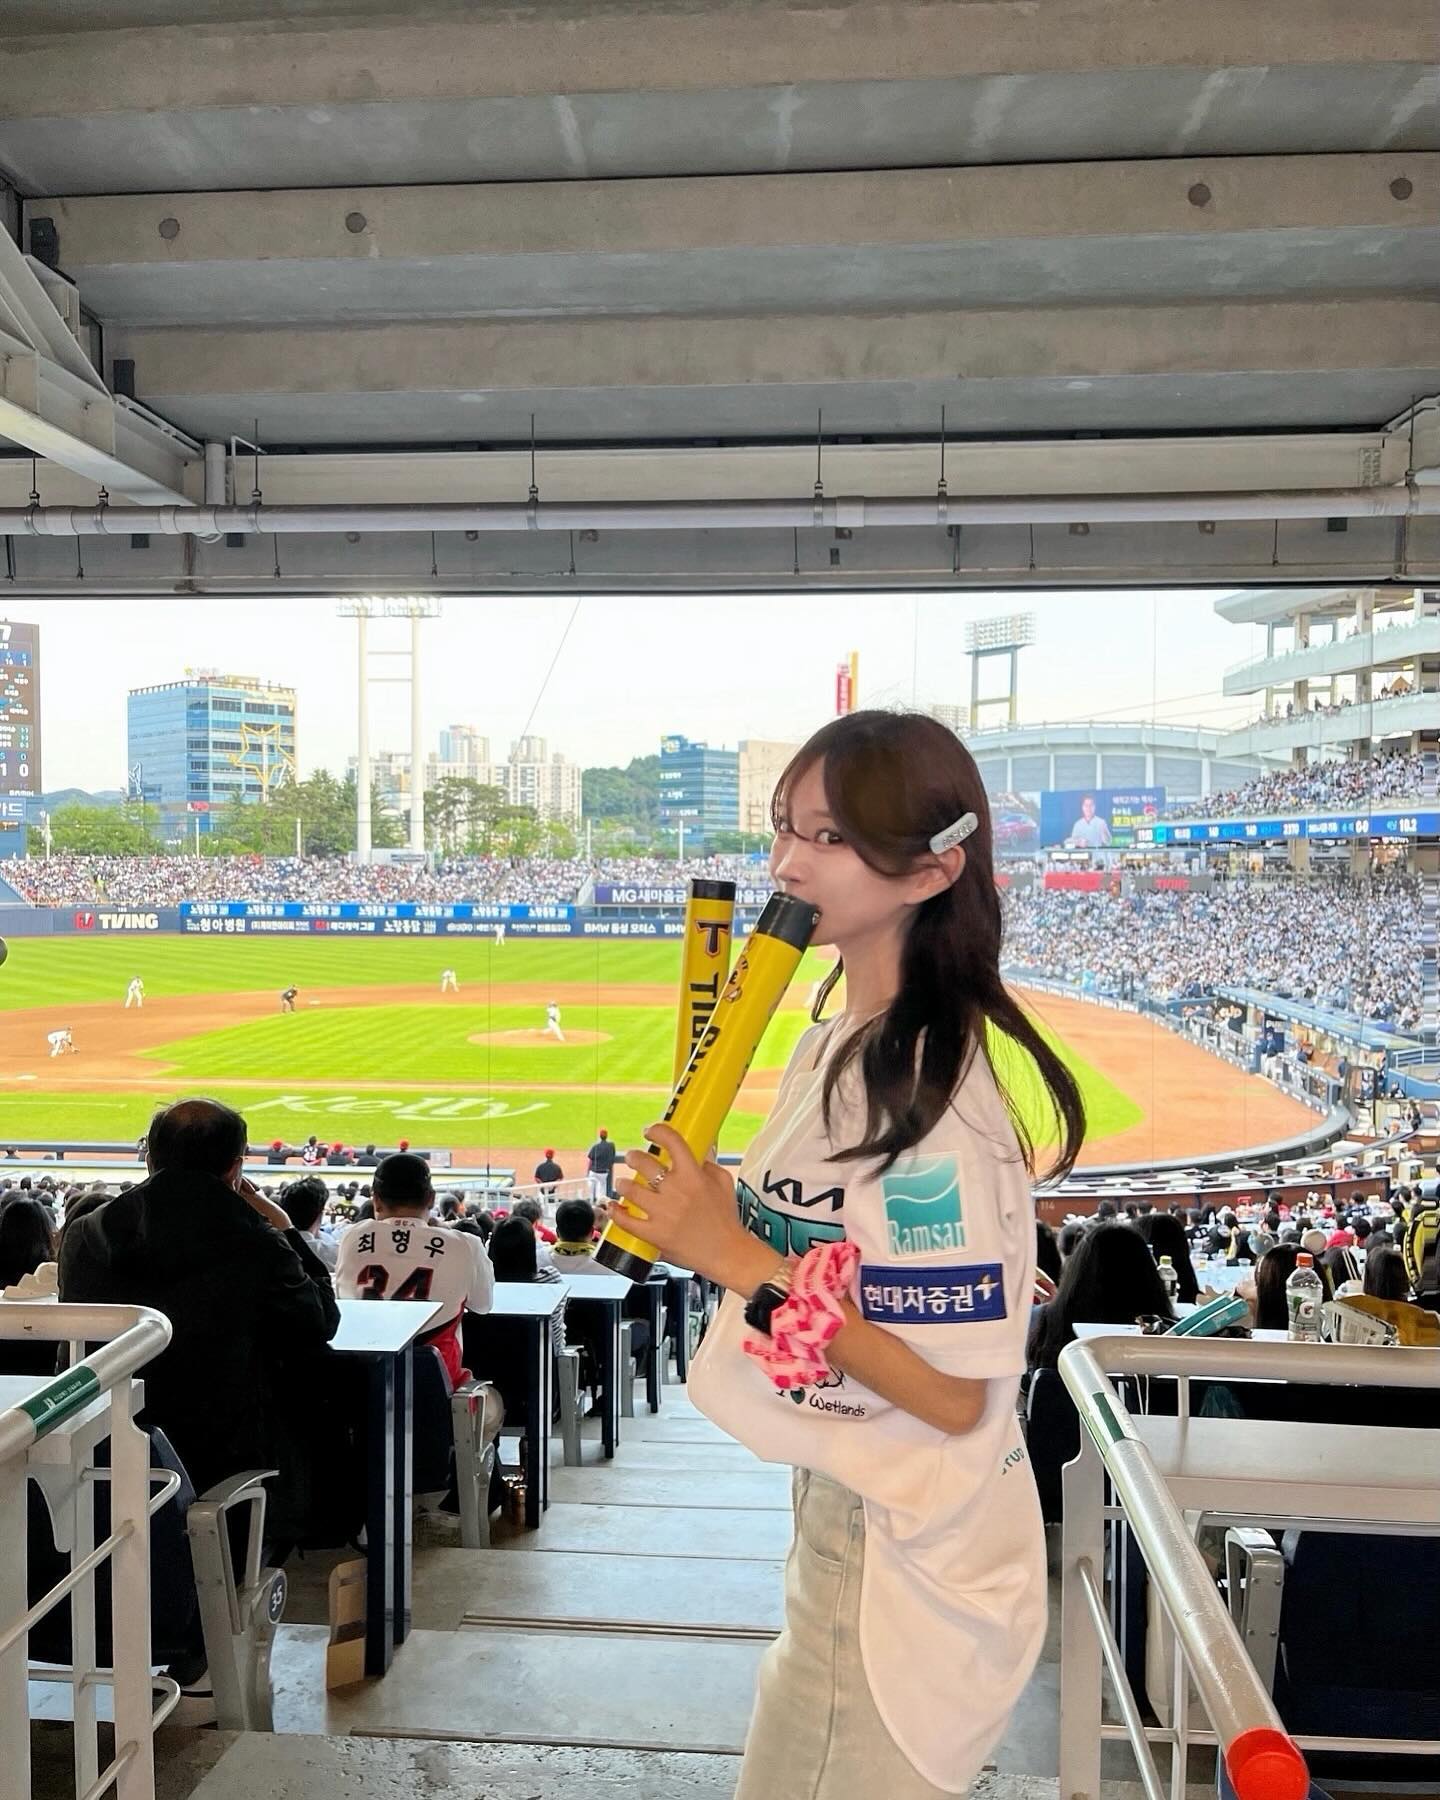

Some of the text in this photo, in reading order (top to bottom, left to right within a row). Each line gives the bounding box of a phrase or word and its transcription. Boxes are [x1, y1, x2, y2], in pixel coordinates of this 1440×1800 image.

[20, 763, 29, 777] 0
[612, 889, 688, 903] MG새마을금
[99, 913, 159, 929] TVING
[584, 923, 609, 933] BMW
[243, 1095, 550, 1121] Kelly
[763, 1170, 845, 1212] KIA
[357, 1229, 445, 1258] 최형우
[886, 1219, 966, 1255] Ramsar
[863, 1284, 975, 1314] 현대차증권
[809, 1393, 866, 1416] Wetlands
